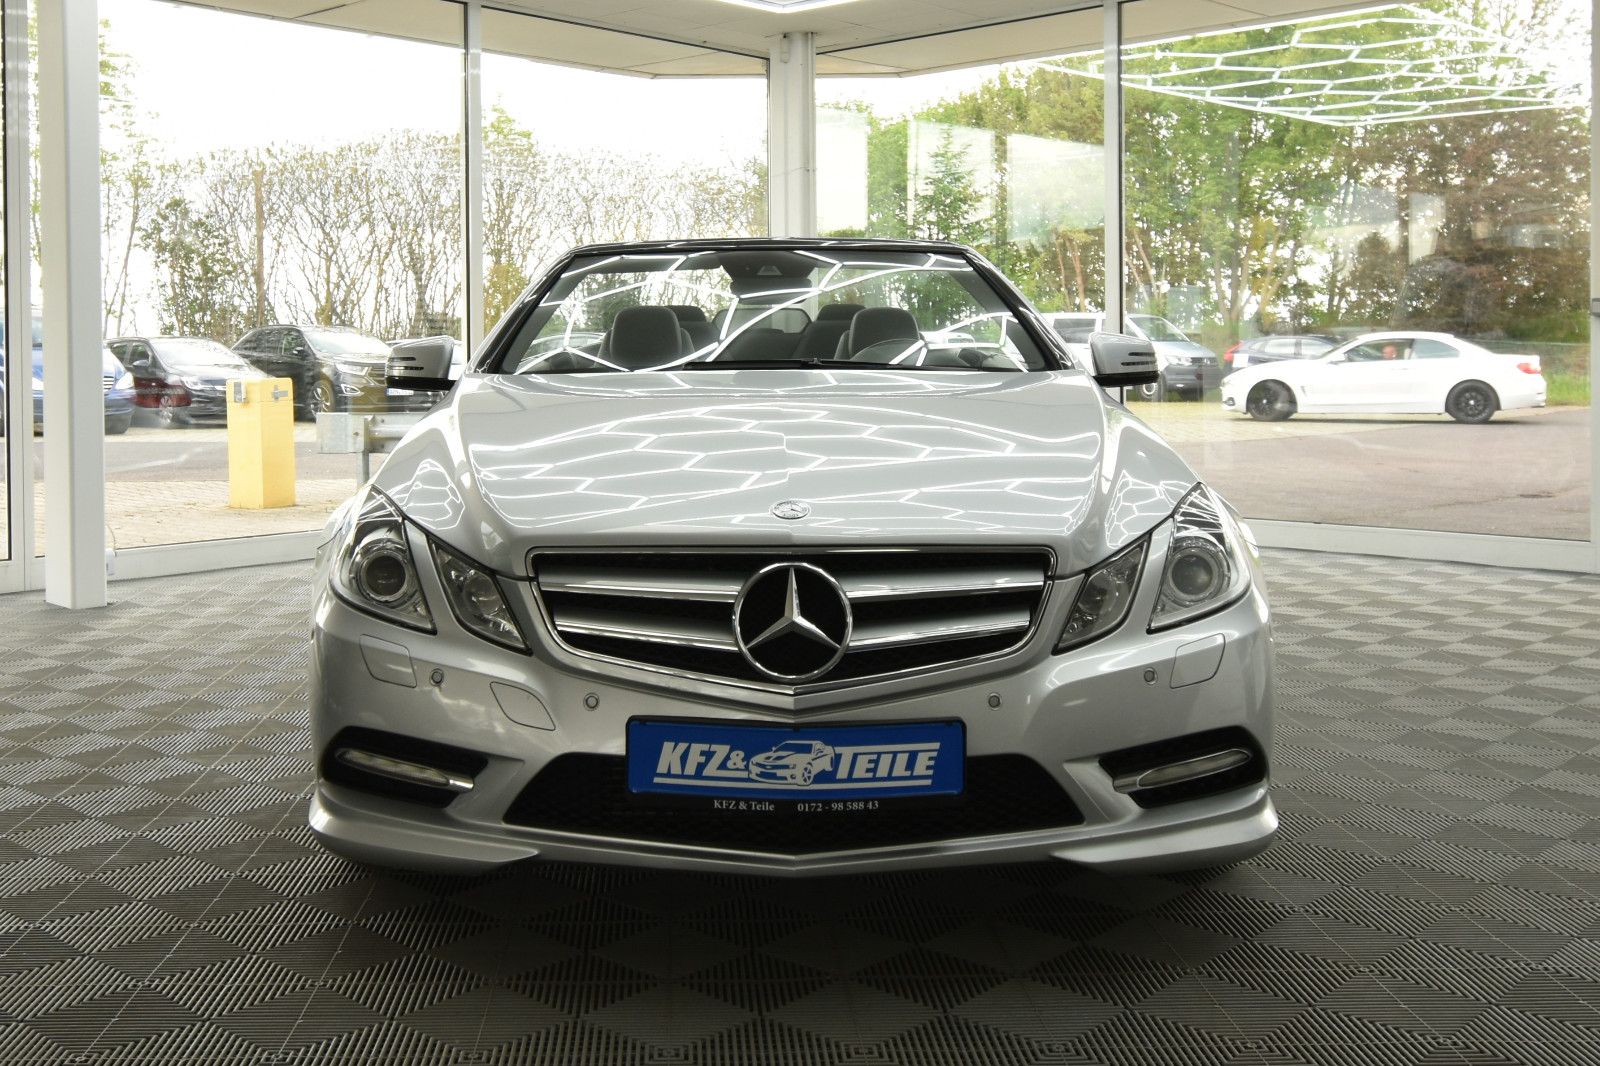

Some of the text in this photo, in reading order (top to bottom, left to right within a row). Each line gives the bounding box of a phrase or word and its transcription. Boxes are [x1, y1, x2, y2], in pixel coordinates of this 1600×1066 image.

[834, 742, 941, 780] TEILE
[713, 800, 737, 810] KFZ
[738, 801, 748, 810] &
[750, 801, 775, 811] Teile
[797, 802, 823, 812] 0172
[831, 802, 844, 811] 98
[846, 801, 865, 811] 588
[866, 800, 879, 810] 43
